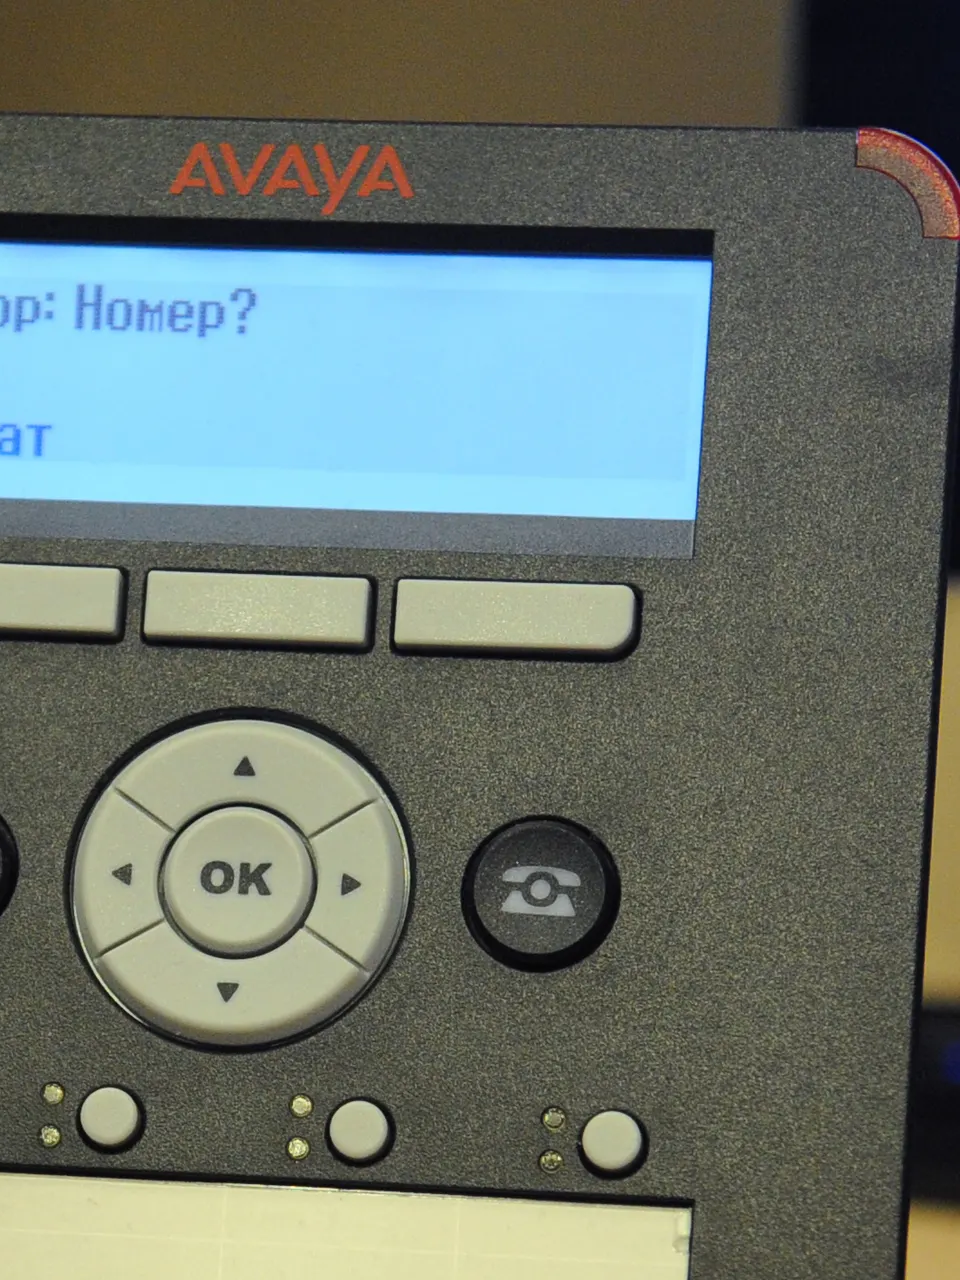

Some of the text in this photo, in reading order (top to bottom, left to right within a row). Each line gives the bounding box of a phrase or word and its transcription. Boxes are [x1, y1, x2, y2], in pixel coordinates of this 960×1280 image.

[169, 142, 415, 216] AVAYA
[74, 283, 257, 338] Номер?
[200, 859, 273, 897] OK
